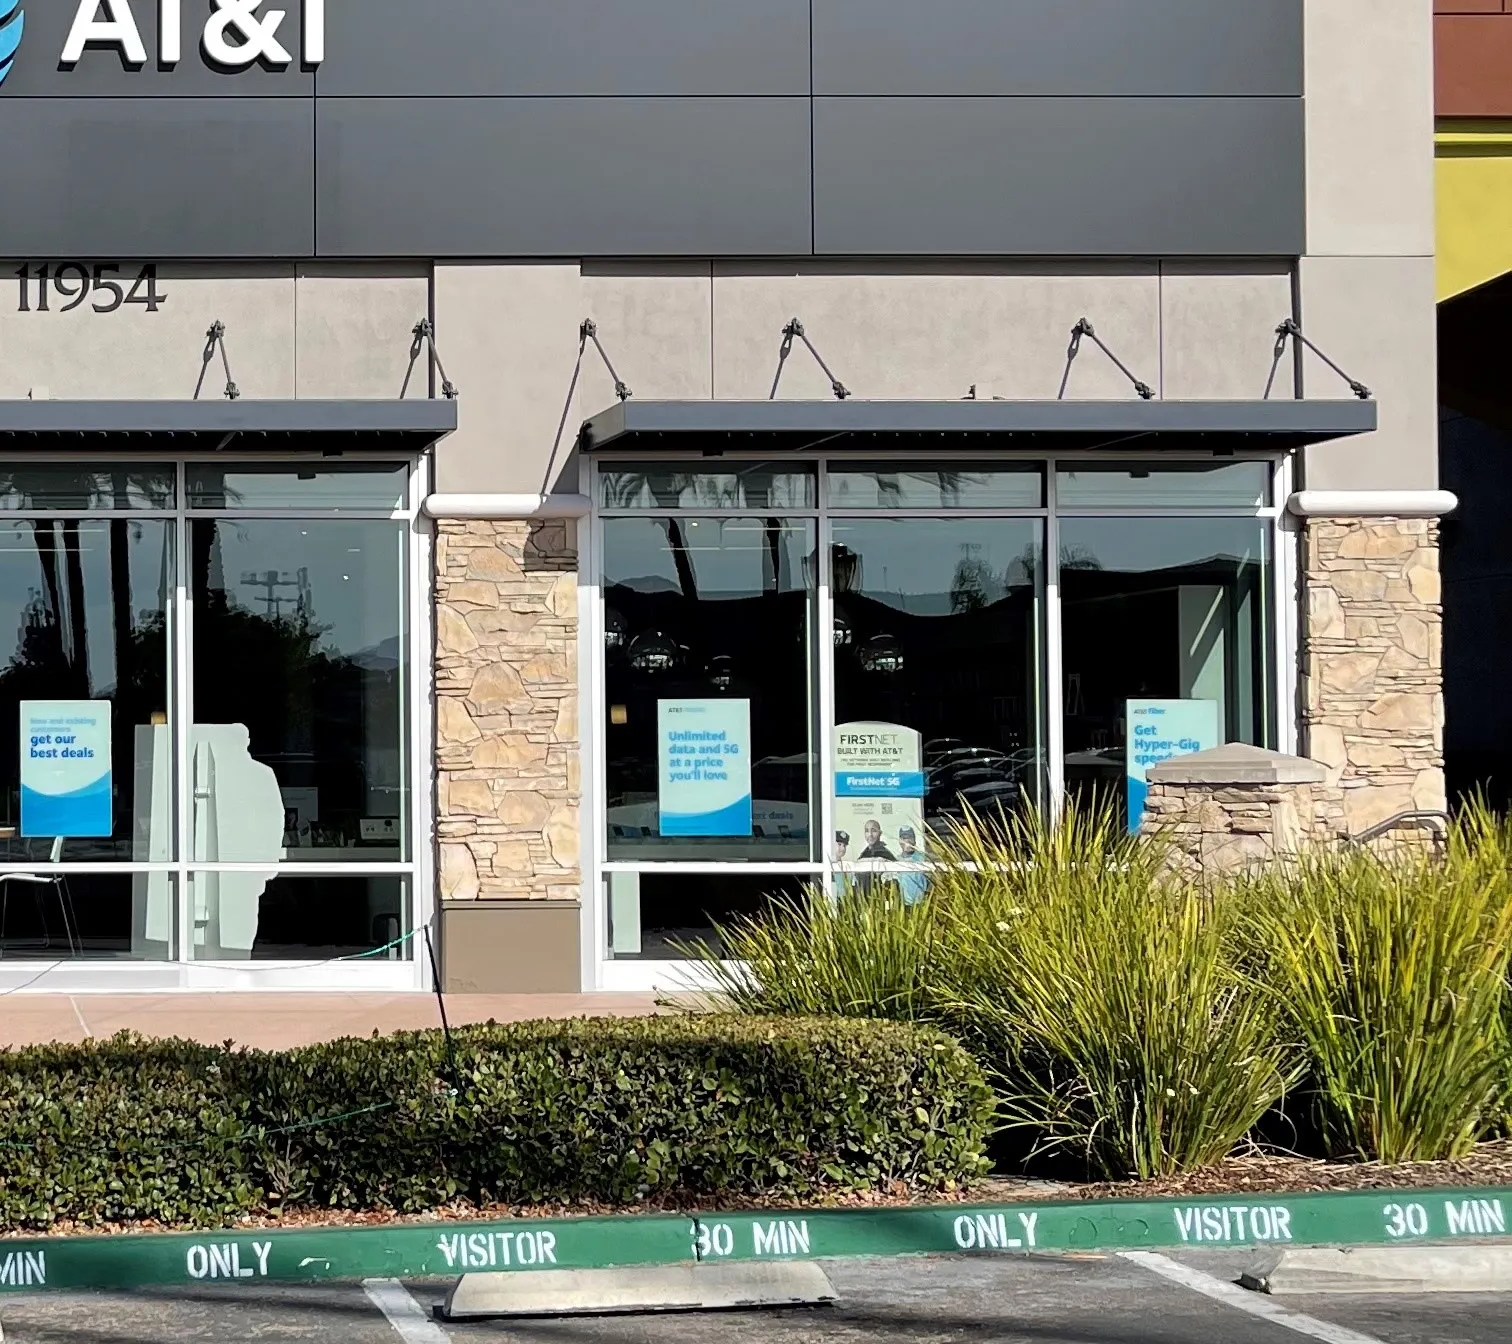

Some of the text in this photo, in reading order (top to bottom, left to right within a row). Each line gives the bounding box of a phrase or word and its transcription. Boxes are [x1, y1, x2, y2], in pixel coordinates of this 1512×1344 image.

[14, 260, 169, 313] 11954
[668, 731, 727, 741] Unlimited
[1134, 725, 1157, 736] Get
[30, 735, 77, 747] get our
[840, 734, 899, 745] FIRSTNET
[1134, 737, 1201, 752] Hyper-Gig
[30, 747, 95, 758] best deals
[668, 744, 739, 754] data and 5G
[837, 747, 903, 755] BUILT WITH AT&T
[669, 757, 724, 770] at a price
[669, 770, 728, 782] you'll love
[846, 776, 885, 786] FirstNet
[1173, 1199, 1505, 1241] VISITOR 30 MIN
[436, 1212, 1038, 1267] VISITOR 30 MIN ONLY
[187, 1241, 273, 1279] ONLY
